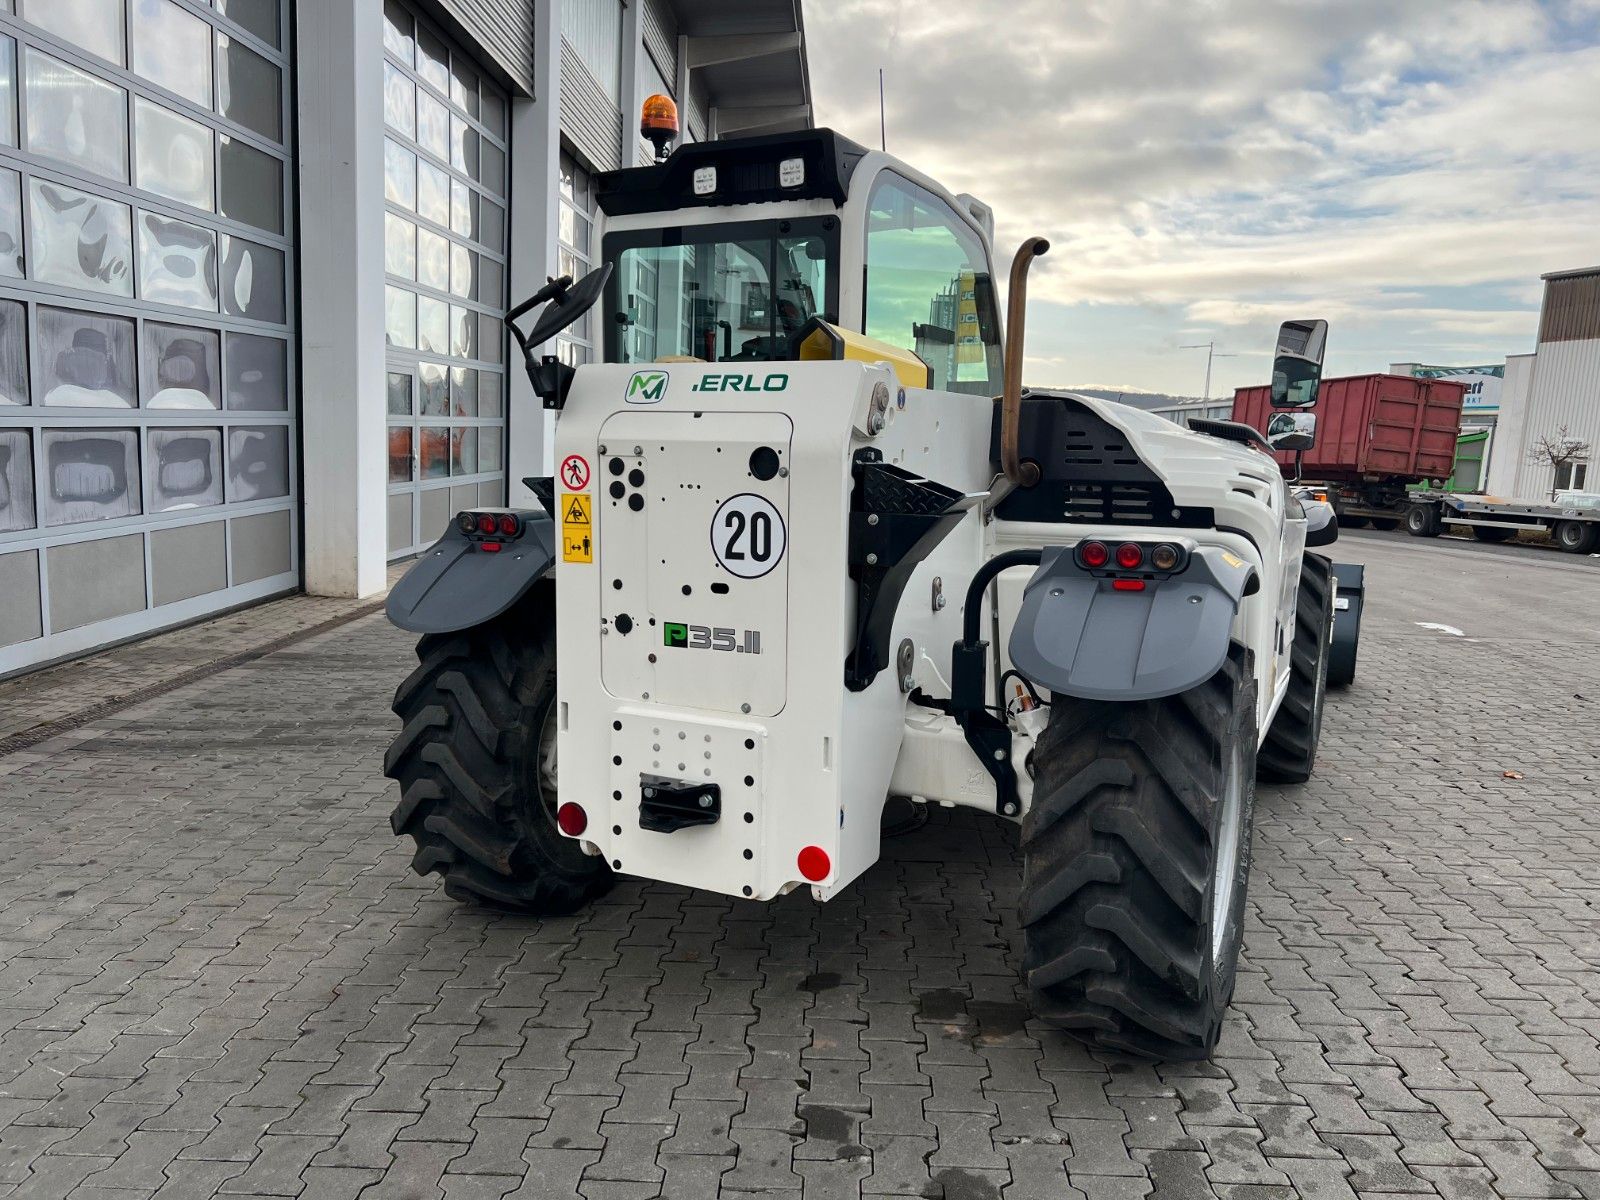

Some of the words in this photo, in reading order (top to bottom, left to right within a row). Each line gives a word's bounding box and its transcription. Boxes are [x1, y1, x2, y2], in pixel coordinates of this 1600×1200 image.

[961, 291, 976, 300] JC
[692, 374, 789, 392] ERLO
[724, 510, 772, 563] 20
